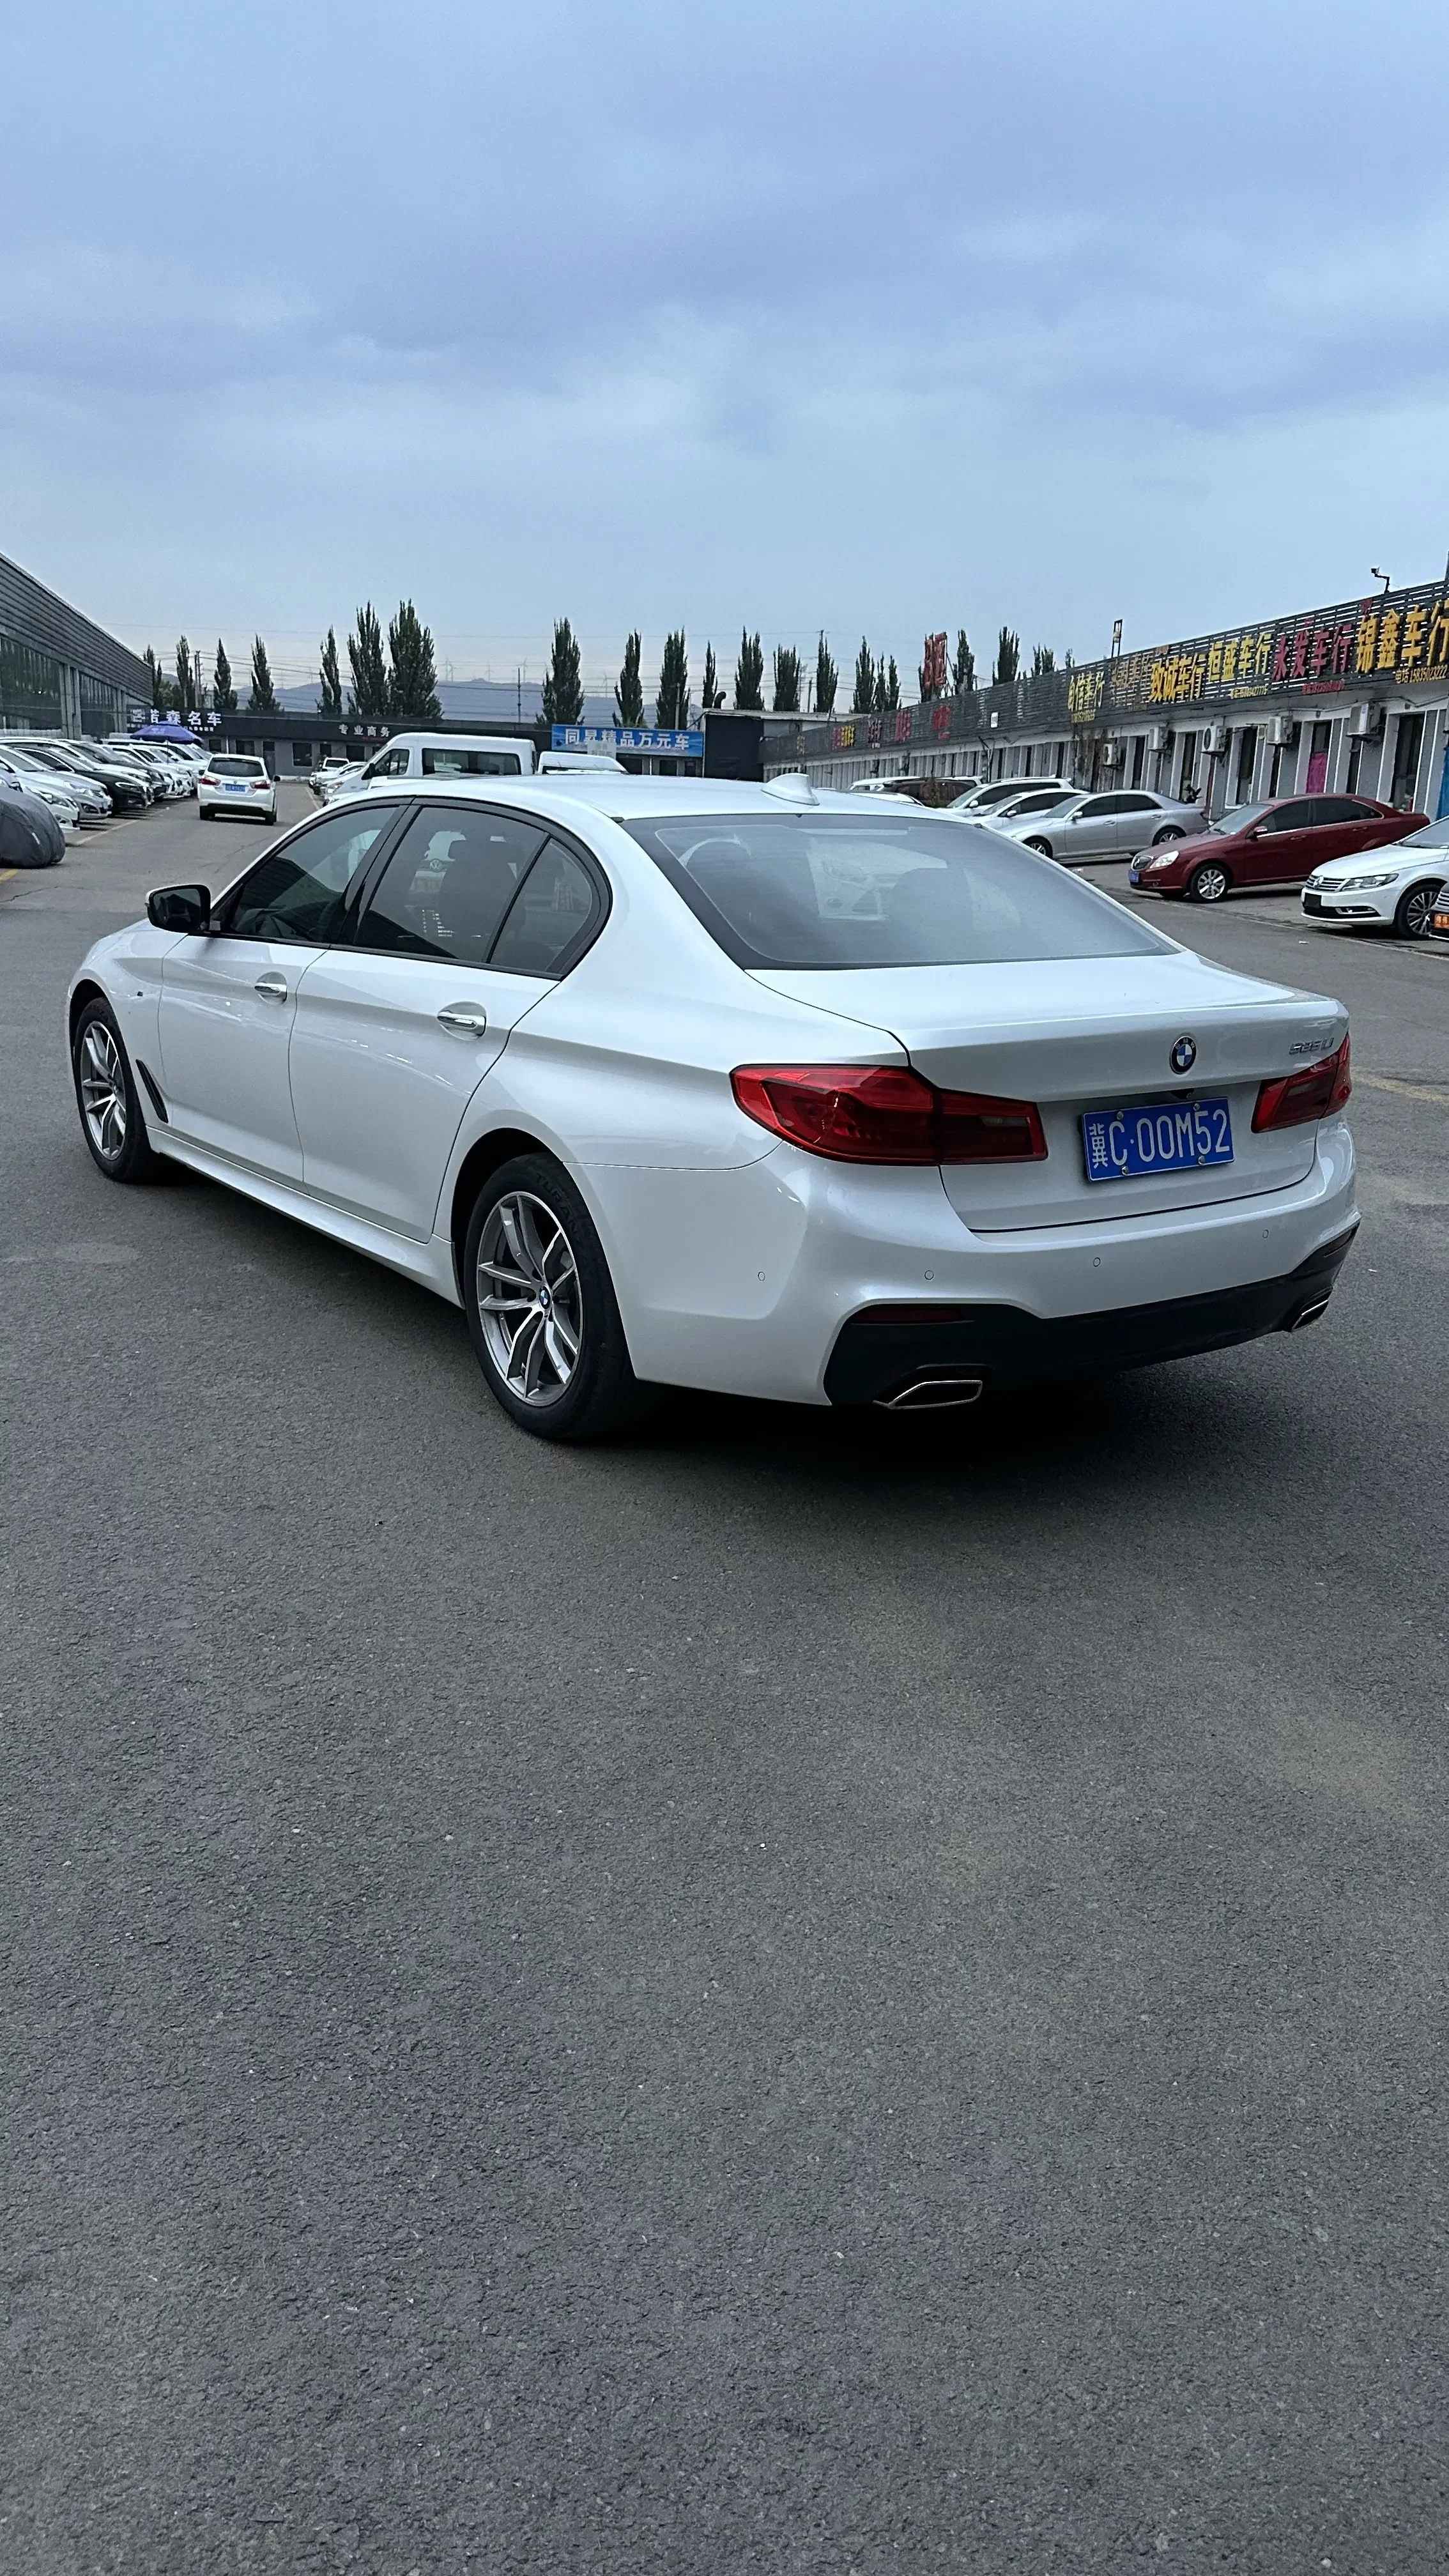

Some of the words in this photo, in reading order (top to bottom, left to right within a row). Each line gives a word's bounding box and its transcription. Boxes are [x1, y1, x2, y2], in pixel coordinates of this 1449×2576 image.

[1208, 632, 1271, 682] 恒盛车行
[1355, 599, 1449, 673] 锦鑫车行
[1148, 652, 1206, 702] 致诚车行
[339, 724, 390, 737] 专业商务
